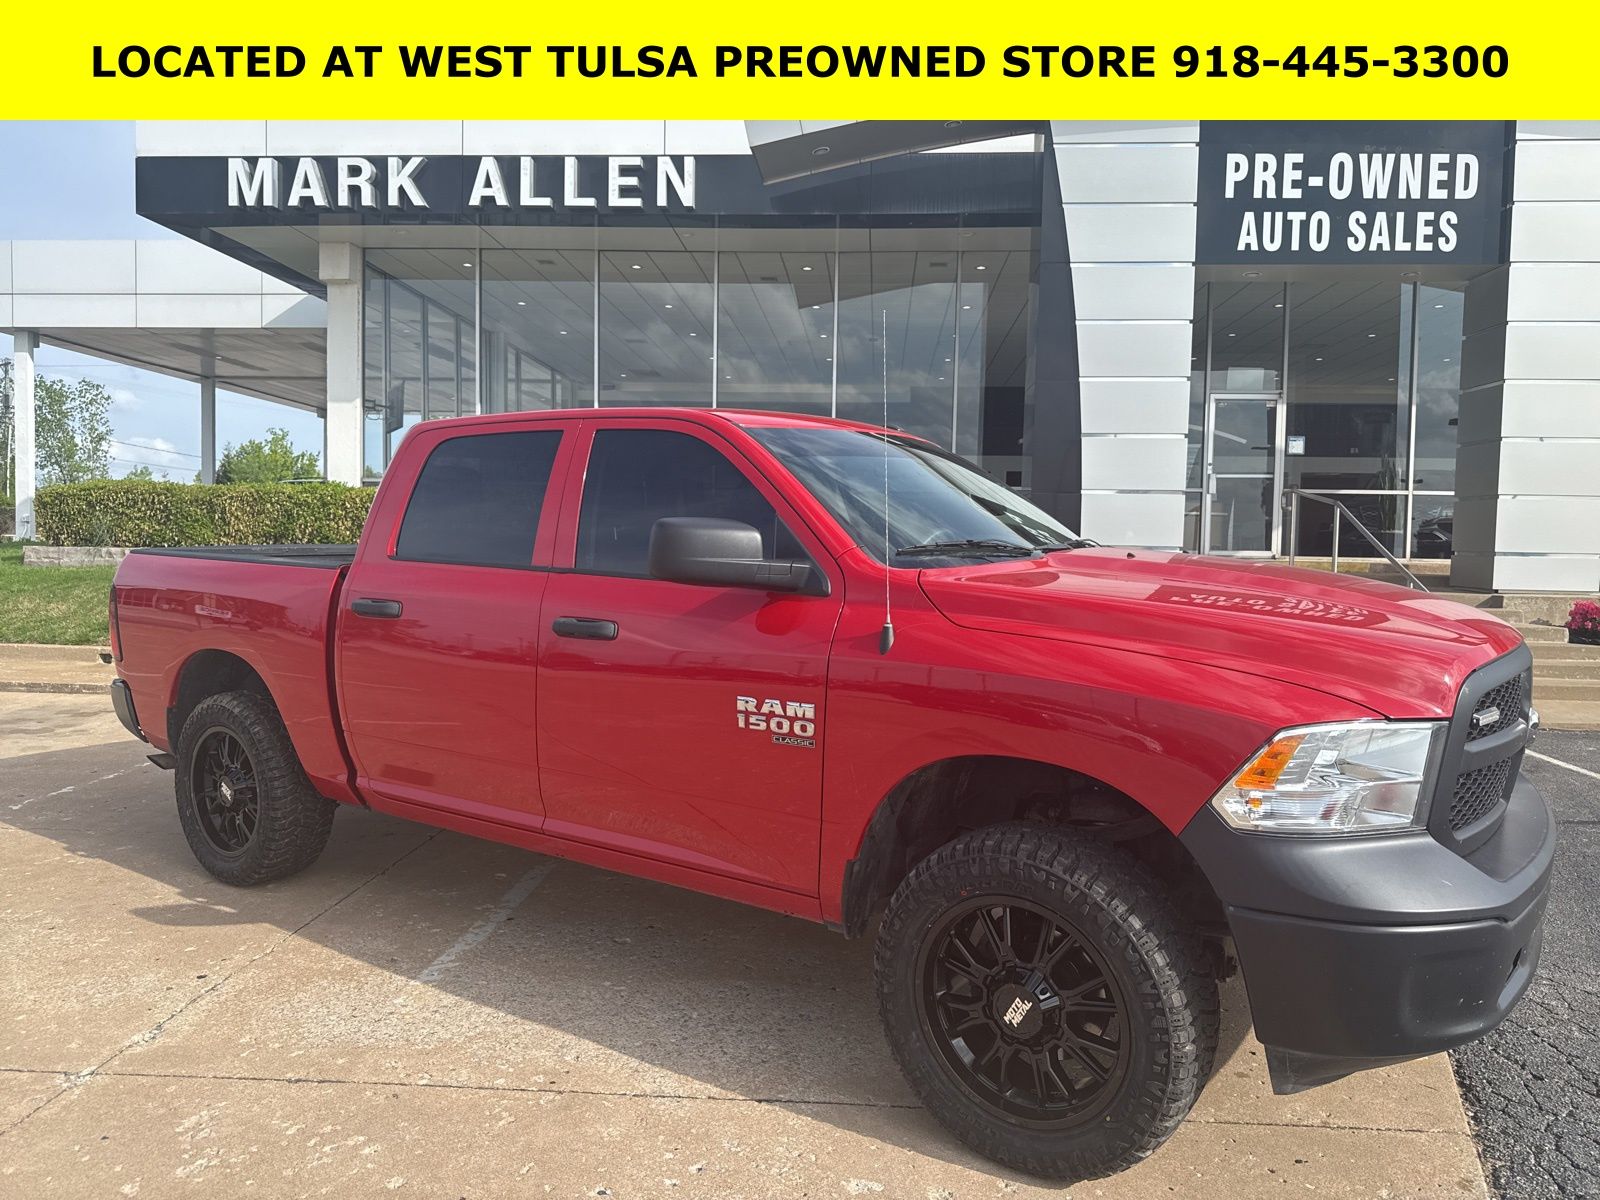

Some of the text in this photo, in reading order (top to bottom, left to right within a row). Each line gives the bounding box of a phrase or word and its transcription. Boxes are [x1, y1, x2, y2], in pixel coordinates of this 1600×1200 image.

[227, 156, 697, 208] MARK ALLEN
[1225, 152, 1480, 200] PRE-OWNED
[1237, 210, 1458, 252] AUTO SALES
[736, 695, 815, 720] RAM
[736, 713, 815, 737] 1500
[773, 736, 814, 747] CLASSIC
[1003, 996, 1023, 1025] MOTO
[1010, 999, 1033, 1028] METAL
